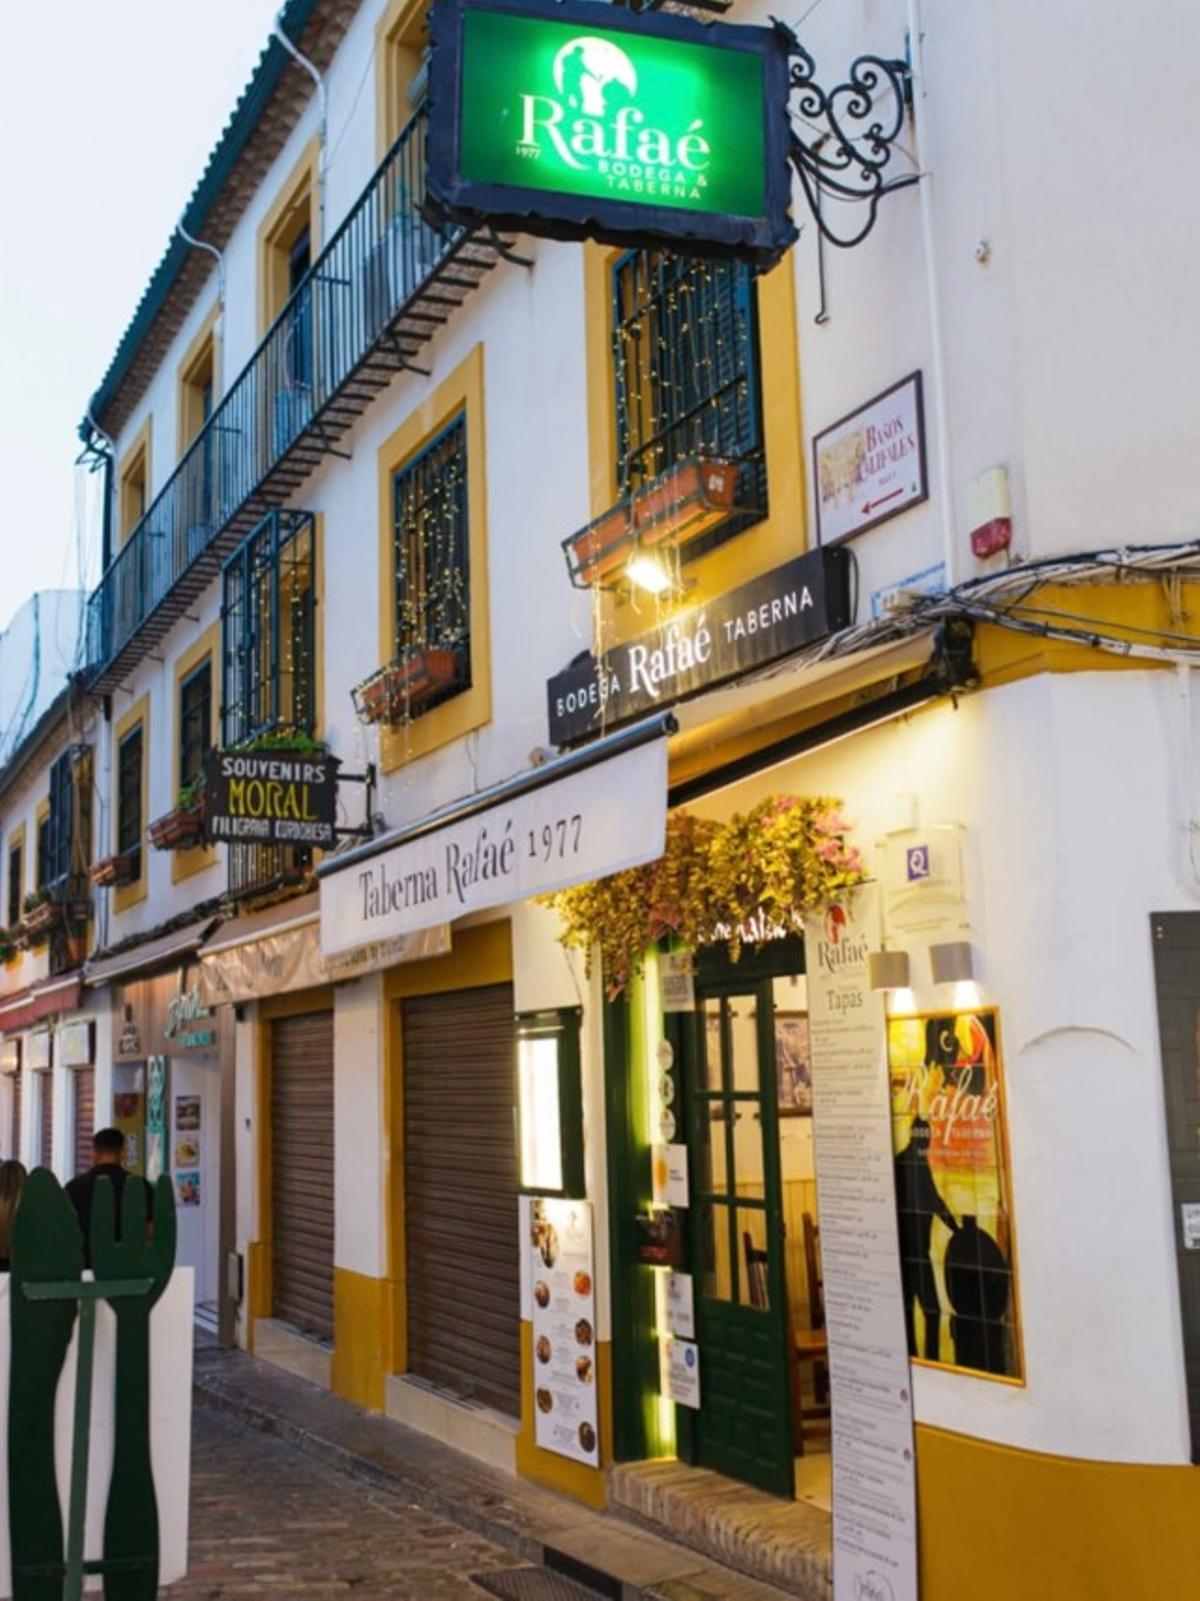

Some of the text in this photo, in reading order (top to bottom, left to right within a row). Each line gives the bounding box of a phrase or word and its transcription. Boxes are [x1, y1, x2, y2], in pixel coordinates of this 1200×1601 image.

[518, 93, 710, 171] Rafaé
[515, 145, 541, 159] 1977
[598, 159, 686, 184] BODEGA
[607, 175, 702, 199] TABERNA
[556, 585, 814, 718] BODEGA Rafaé TABERNA
[221, 757, 326, 784] SOUVENIRS
[228, 777, 319, 822] MORAL
[359, 814, 583, 921] Taberna Rafaé 1977
[825, 987, 864, 1016] Tapas
